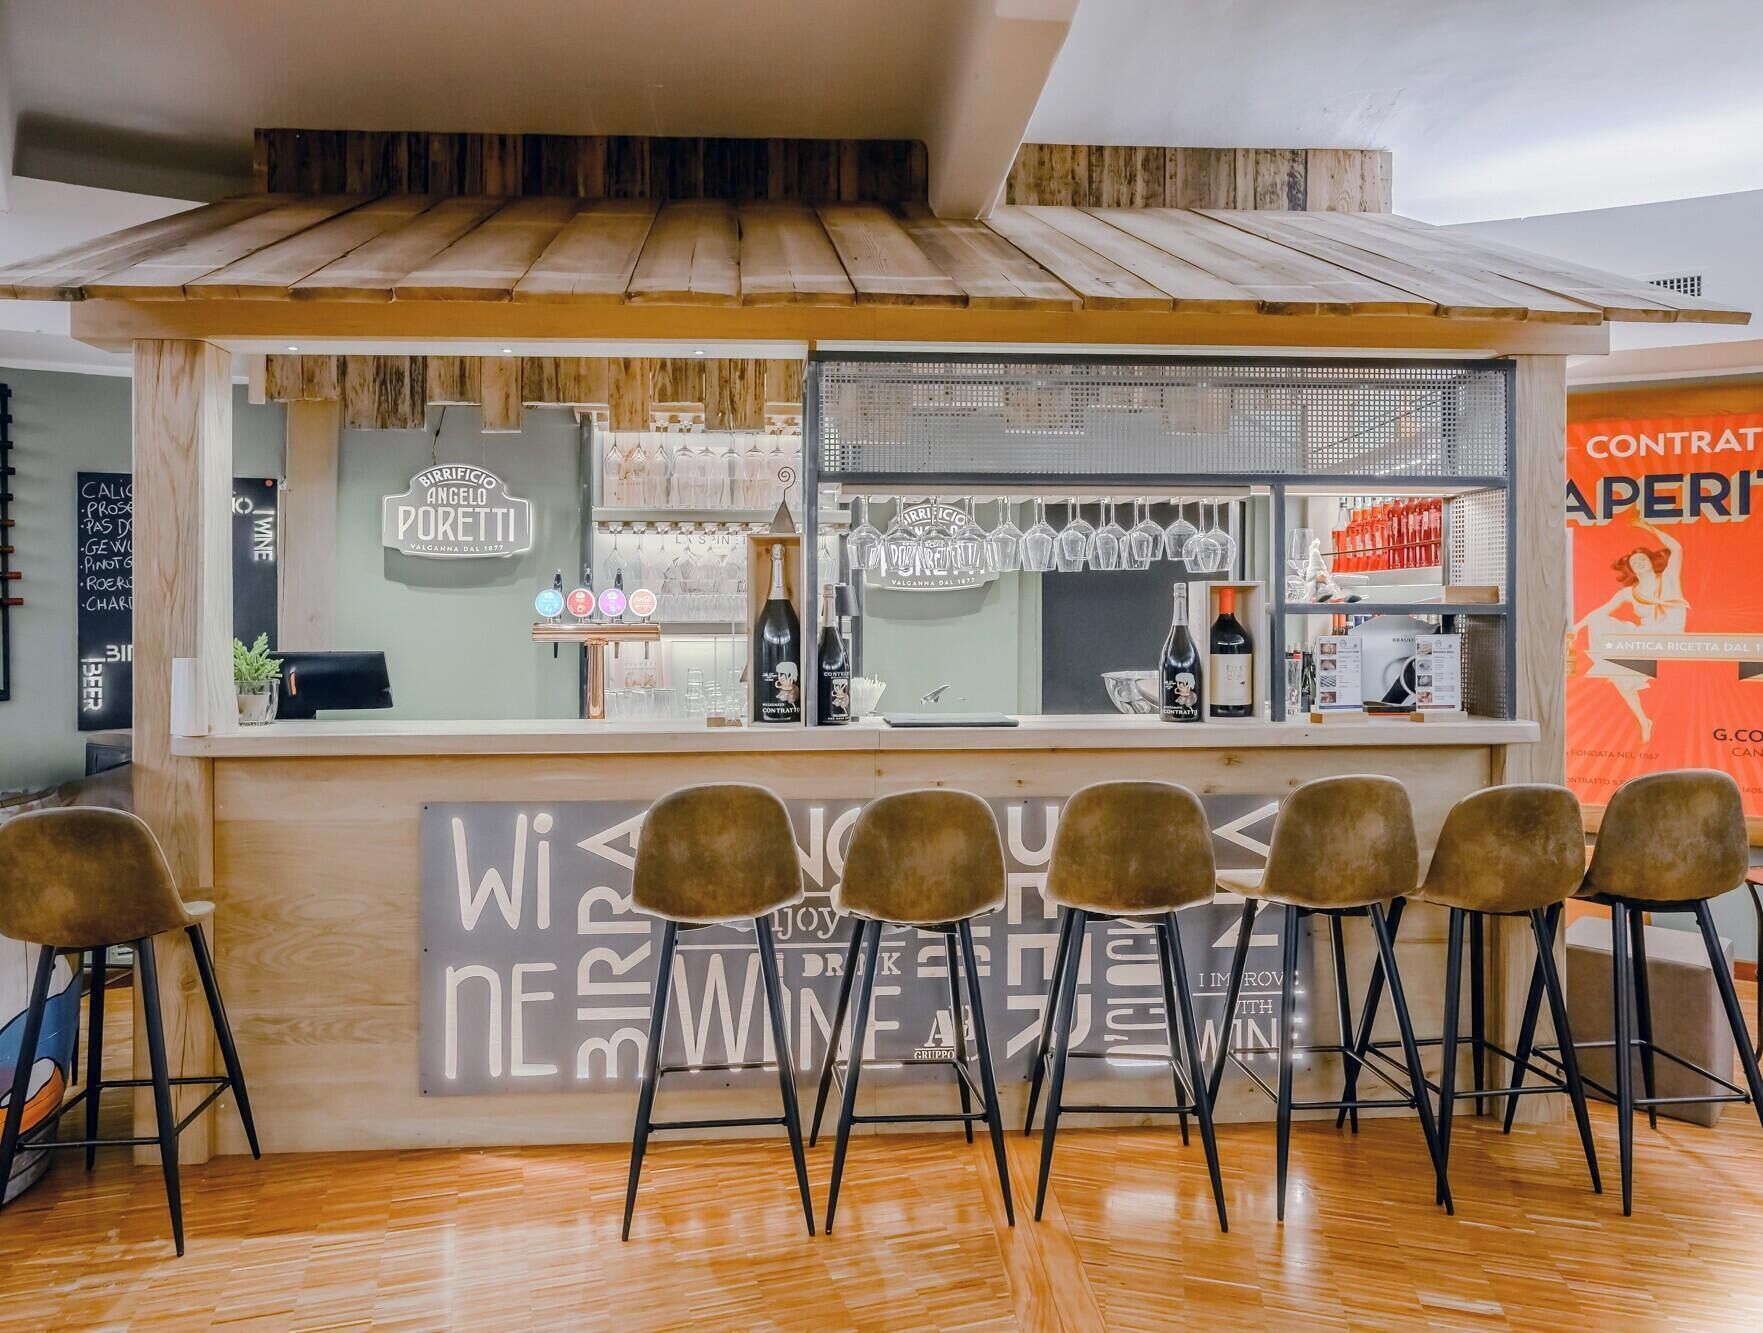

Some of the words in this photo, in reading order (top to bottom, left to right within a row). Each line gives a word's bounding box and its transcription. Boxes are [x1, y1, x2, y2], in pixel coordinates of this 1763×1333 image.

[1586, 427, 1763, 459] CONTRAT
[418, 467, 497, 489] BIRRIFICIO
[426, 487, 487, 505] ANGELO
[1566, 469, 1763, 526] APERI
[84, 518, 113, 535] PAS
[398, 506, 515, 542] PORETTI
[253, 516, 274, 561] WINE
[410, 543, 459, 552] VALGANNA
[1616, 641, 1664, 650] ANTICA
[1667, 640, 1720, 652] RICETTA
[1723, 642, 1750, 652] DAL
[82, 663, 103, 712] BEER
[1713, 728, 1763, 743] G.CO
[1571, 750, 1614, 758] FONDATA
[801, 953, 902, 977] DRK
[1210, 971, 1299, 987] IMROV
[1199, 1018, 1303, 1062] WIN
[914, 1050, 955, 1059] GRUPPO
